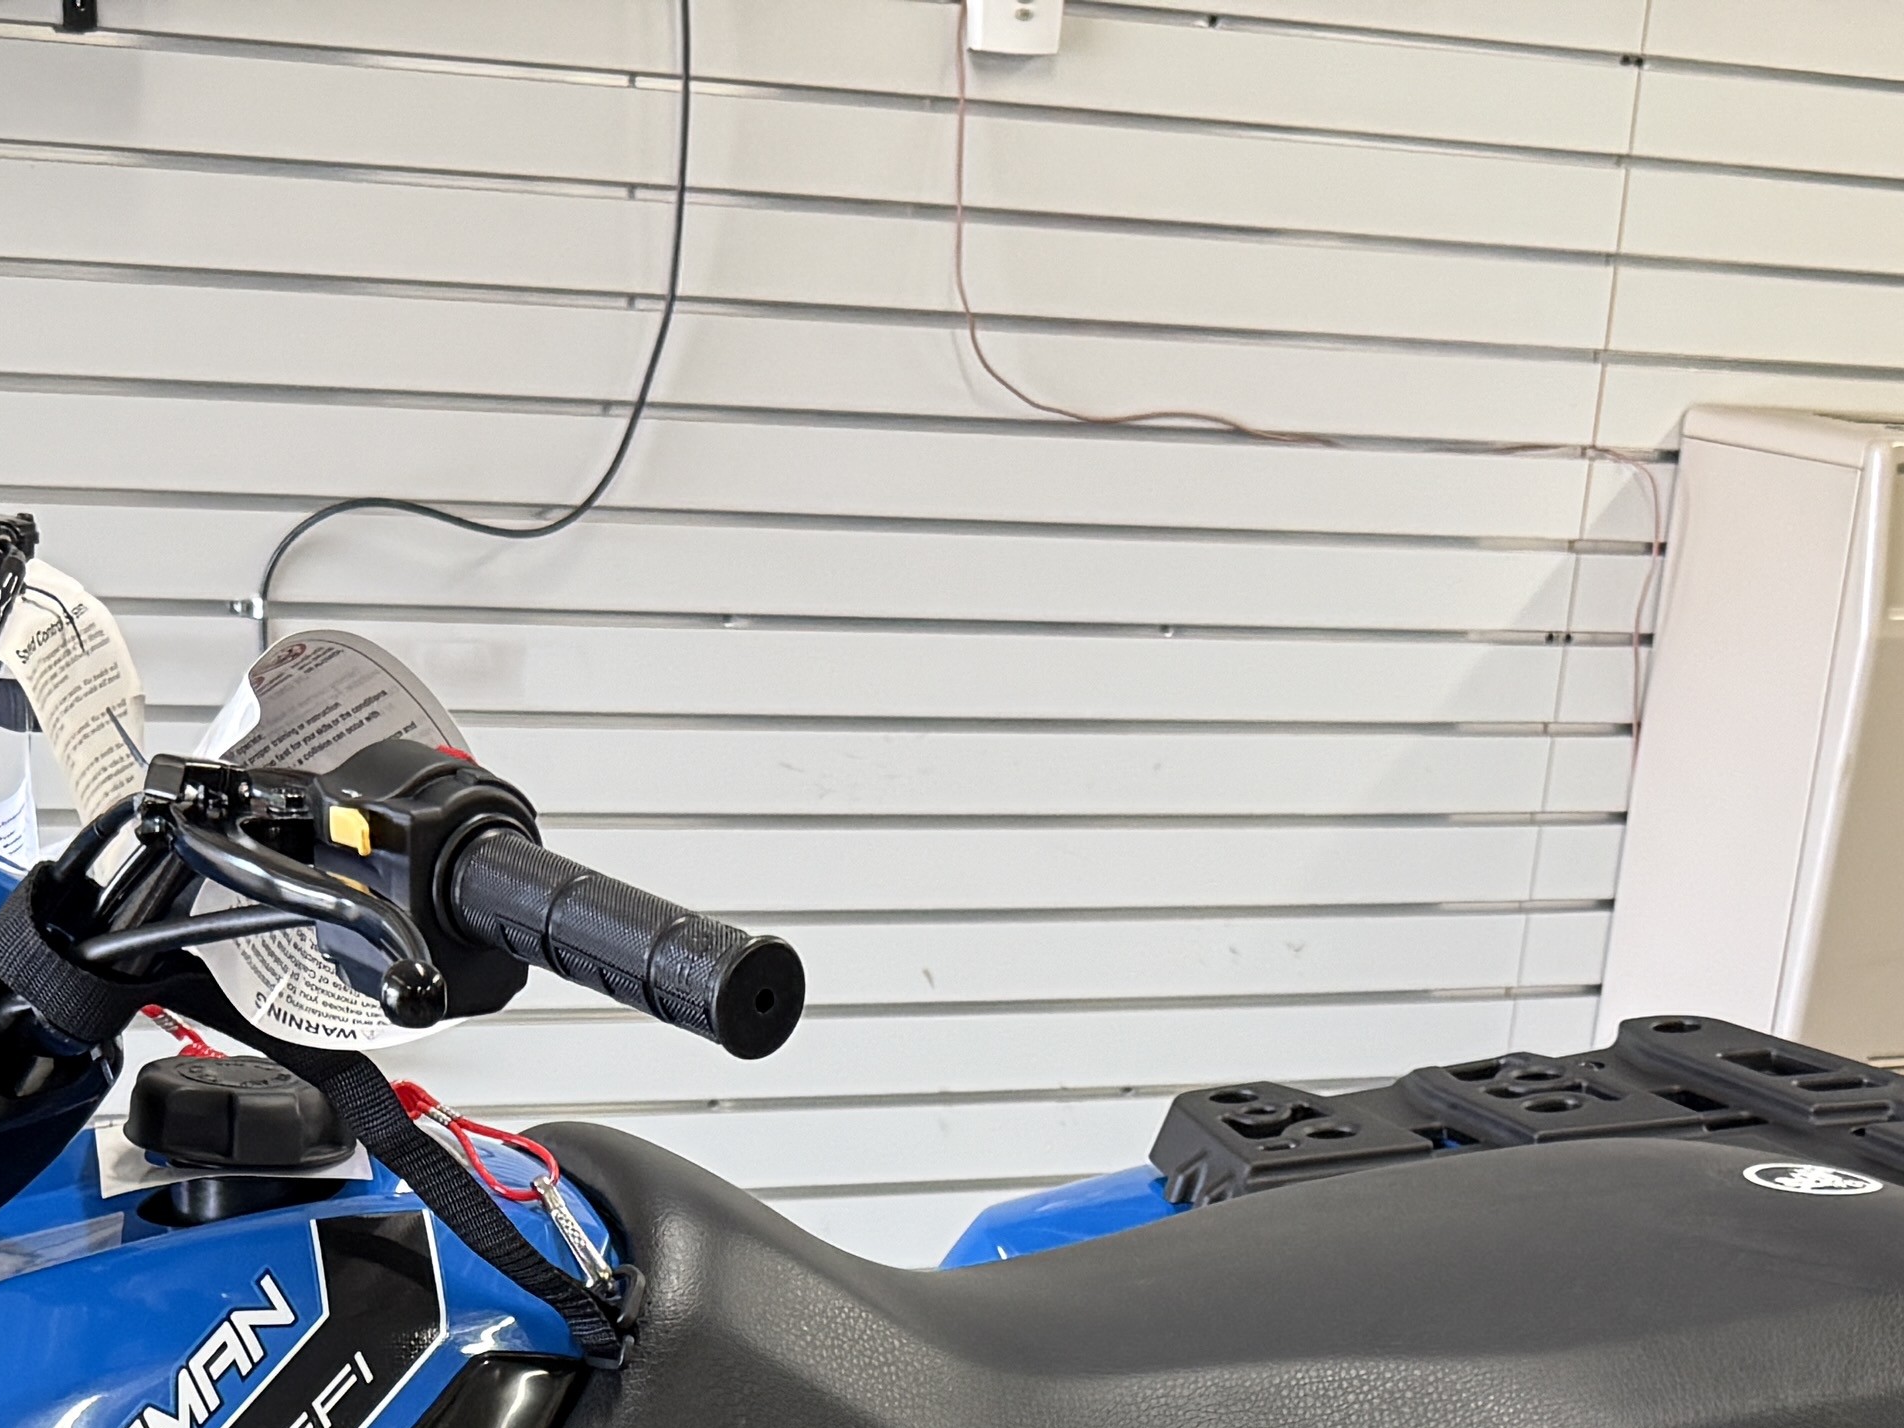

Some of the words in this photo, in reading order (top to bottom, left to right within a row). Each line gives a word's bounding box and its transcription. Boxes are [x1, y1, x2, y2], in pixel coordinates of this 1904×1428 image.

[290, 741, 303, 753] for
[351, 690, 387, 714] conditions
[255, 991, 357, 1040] WARNING
